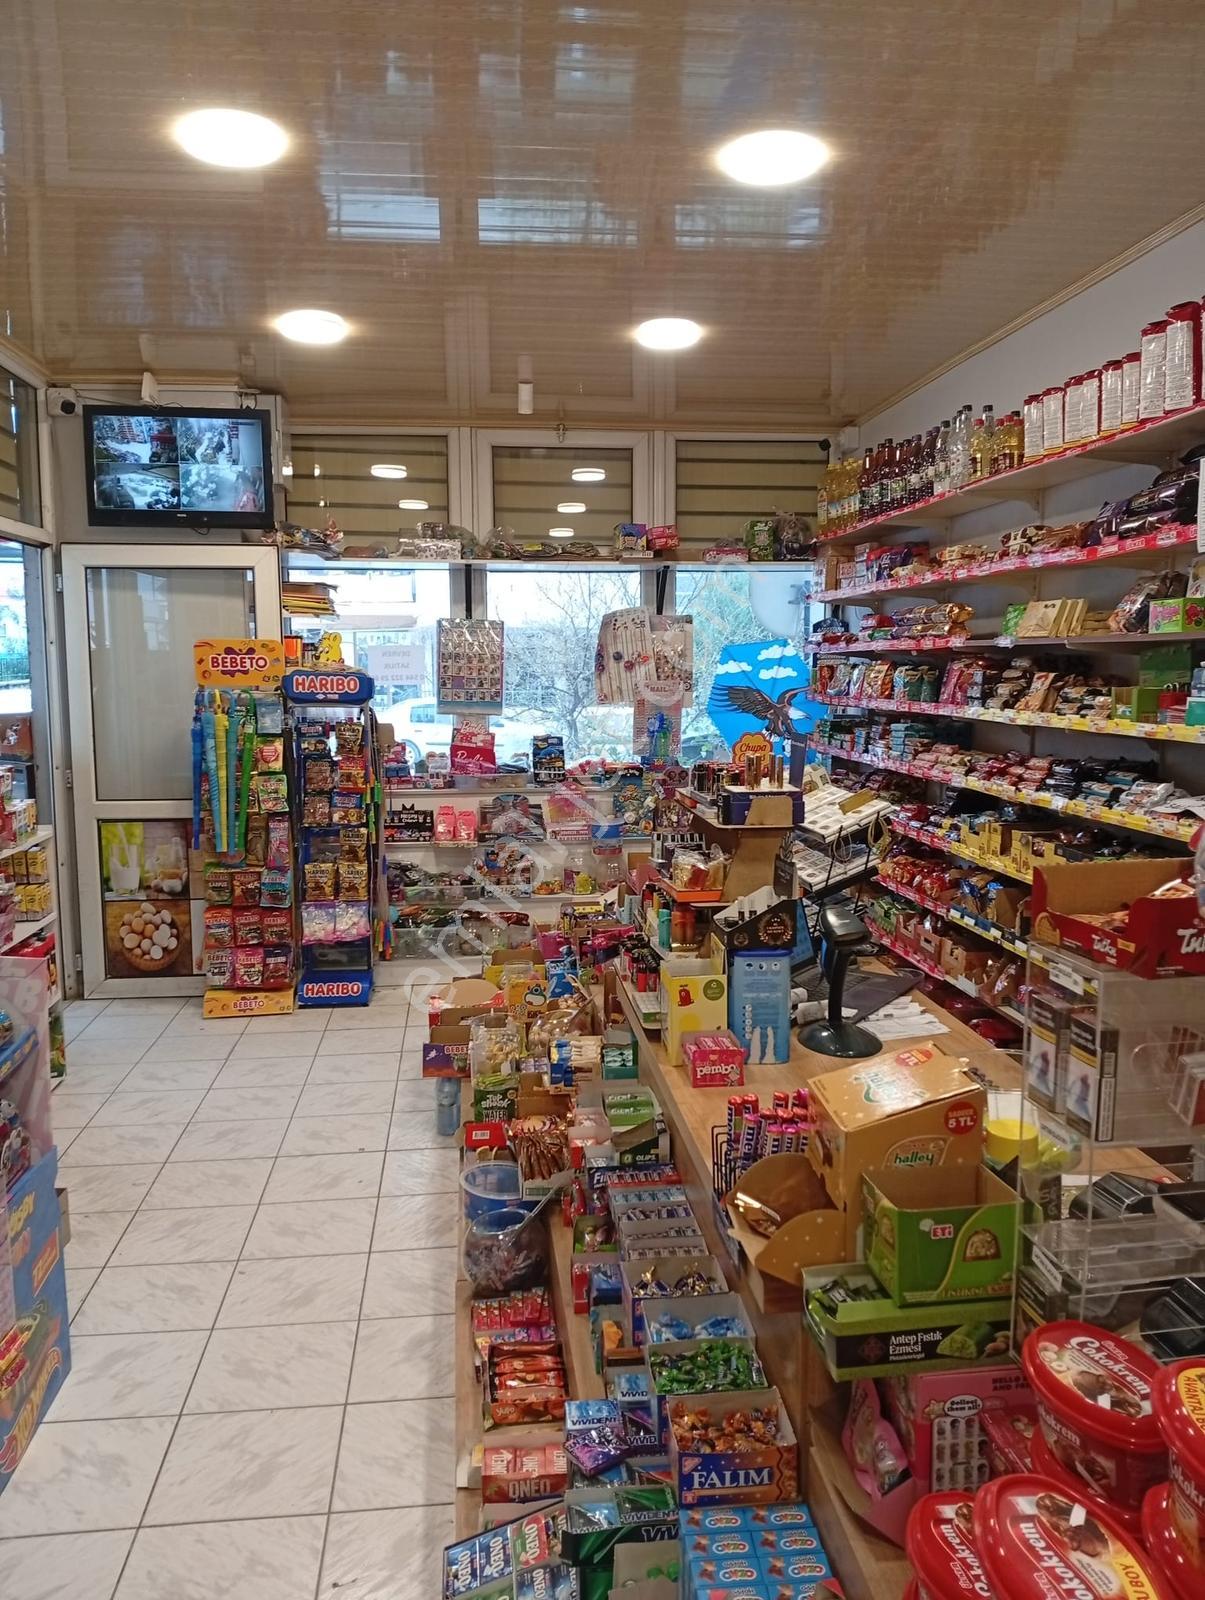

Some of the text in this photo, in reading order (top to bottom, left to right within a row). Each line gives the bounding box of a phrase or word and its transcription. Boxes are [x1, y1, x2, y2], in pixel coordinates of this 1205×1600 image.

[211, 655, 268, 671] BEBETO
[293, 675, 359, 693] HARIBO
[740, 742, 767, 753] Chupa
[303, 981, 363, 998] HARIBO
[232, 1000, 265, 1009] BEBETO
[696, 1063, 736, 1079] pembo
[958, 1116, 975, 1127] TL
[894, 1149, 935, 1166] halley
[889, 1334, 917, 1348] Antep
[889, 1343, 922, 1355] Ezmesi
[1064, 1336, 1151, 1395] Çokokrem
[691, 1467, 772, 1490] FALIM
